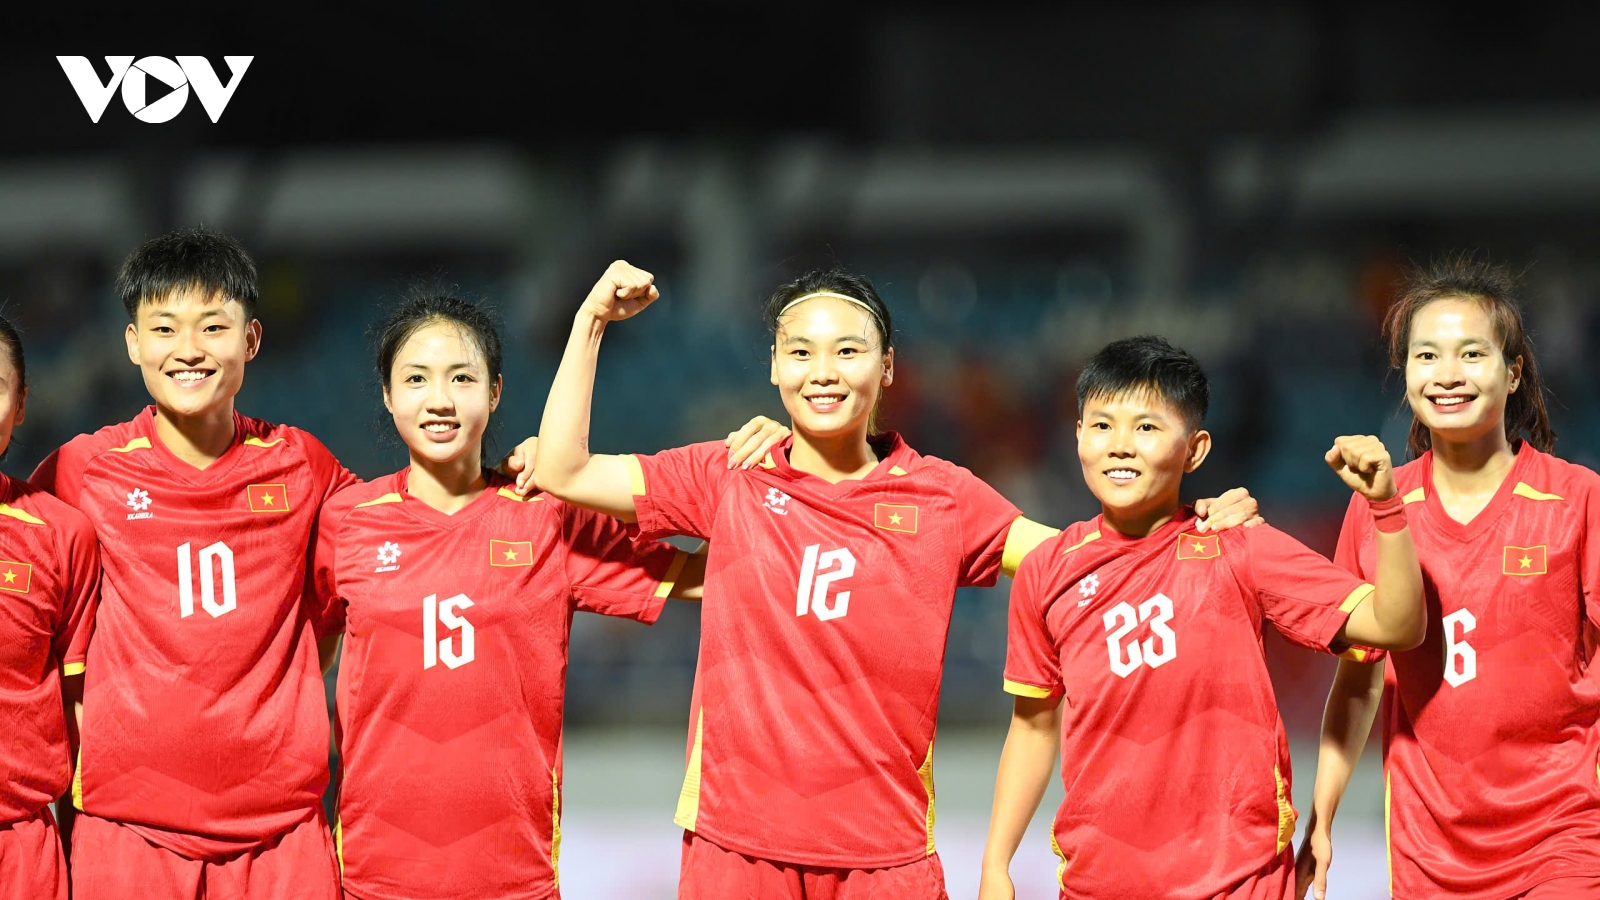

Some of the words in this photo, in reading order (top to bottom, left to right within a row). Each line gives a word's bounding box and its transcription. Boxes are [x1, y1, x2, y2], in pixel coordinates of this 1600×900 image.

[177, 541, 237, 618] 10
[796, 544, 856, 621] 12
[423, 593, 475, 670] 15
[1102, 592, 1177, 679] 23
[1442, 607, 1477, 689] 6
